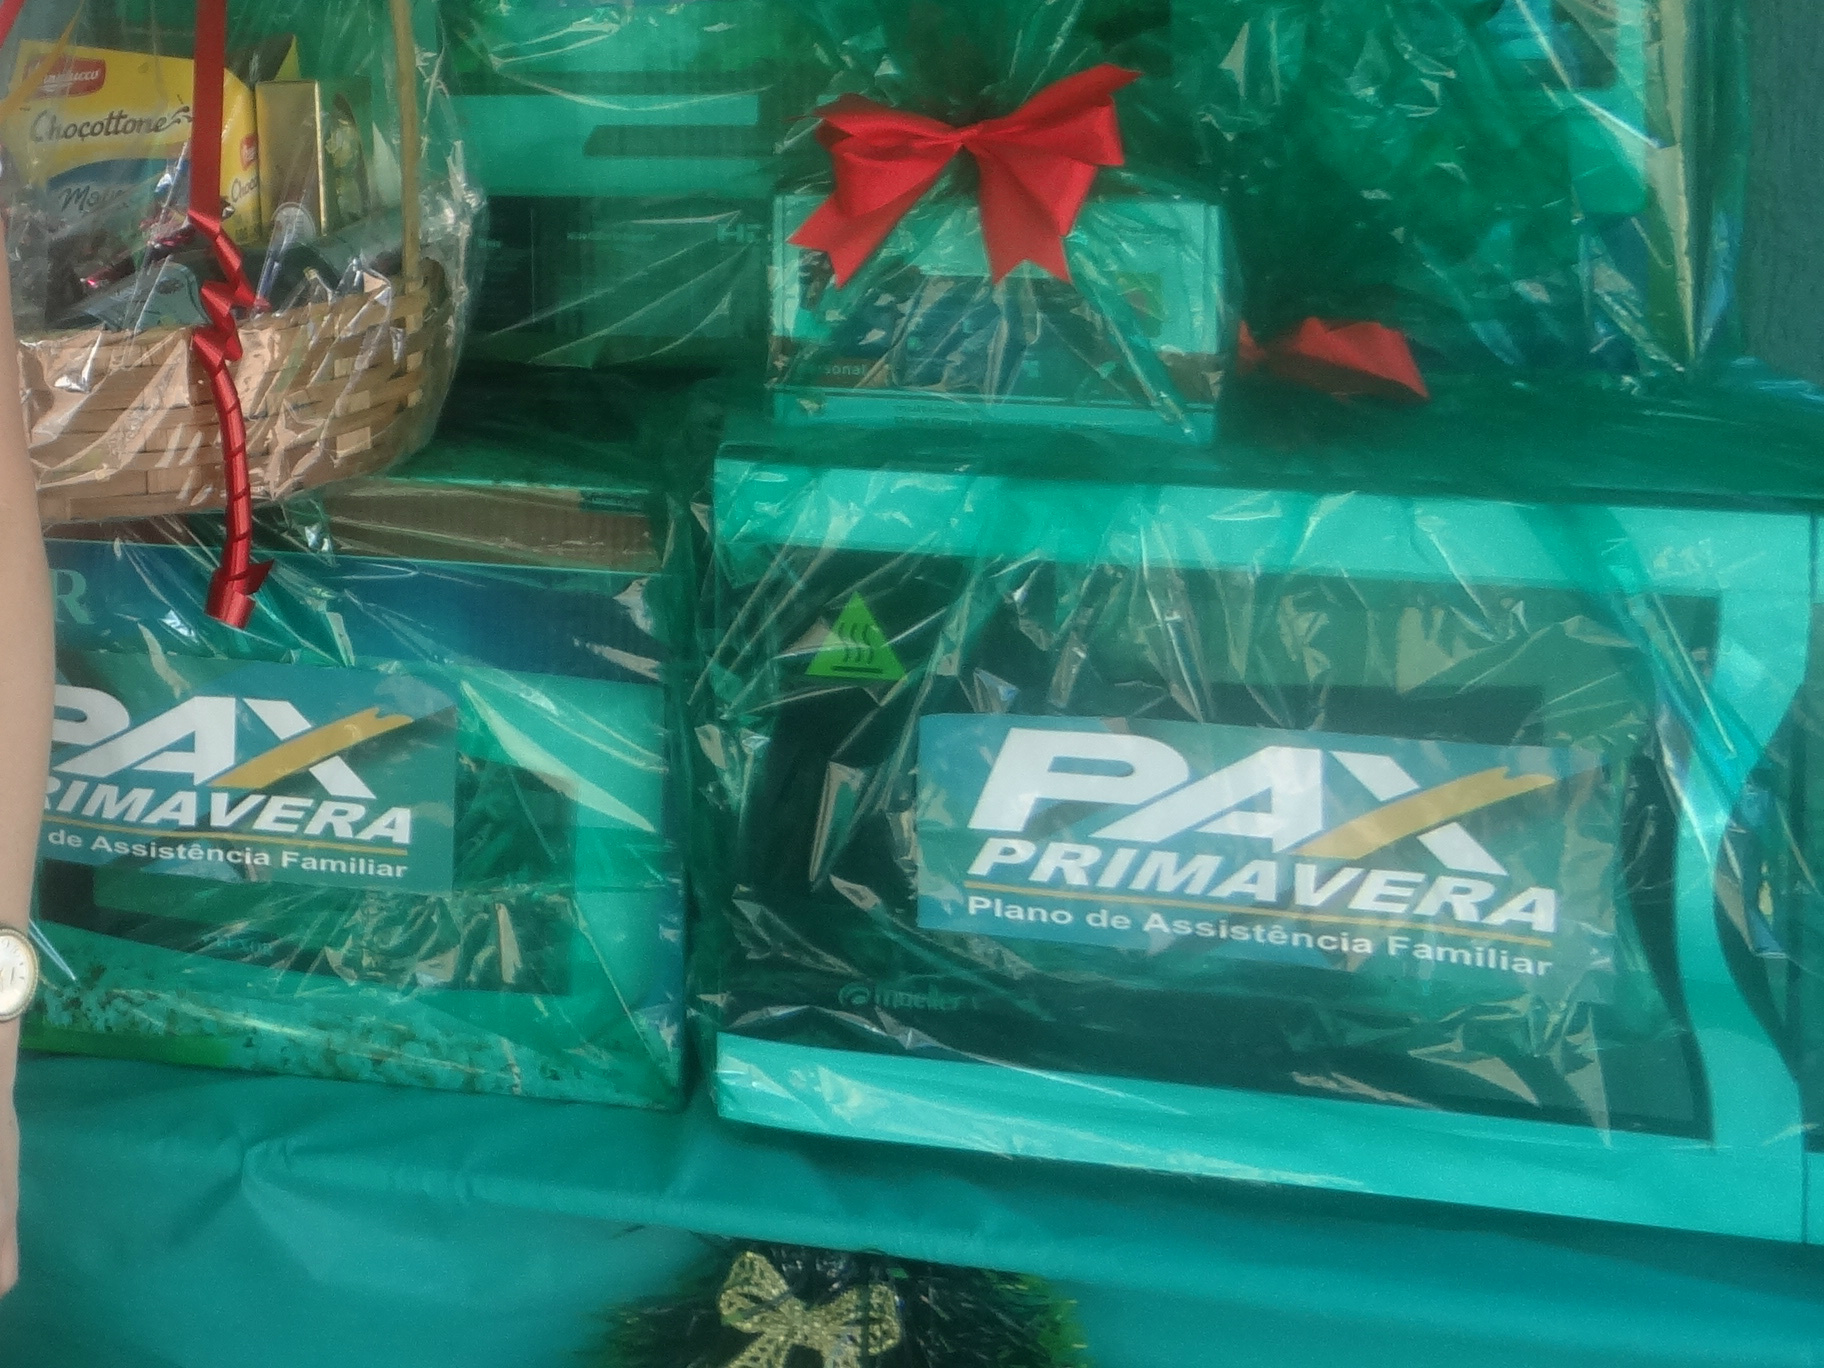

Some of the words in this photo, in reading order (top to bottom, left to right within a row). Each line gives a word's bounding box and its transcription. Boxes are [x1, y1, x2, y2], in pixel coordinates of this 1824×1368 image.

[44, 777, 412, 845] IMAVERA
[966, 728, 1557, 876] PAX
[48, 829, 83, 848] de
[90, 835, 270, 867] Assistência
[281, 850, 409, 878] Familiar
[967, 837, 1557, 933] PRIMAVERA
[968, 896, 1073, 925] Plano
[1086, 909, 1132, 930] de
[1142, 912, 1374, 955] Assistência
[1386, 935, 1553, 977] Familiar
